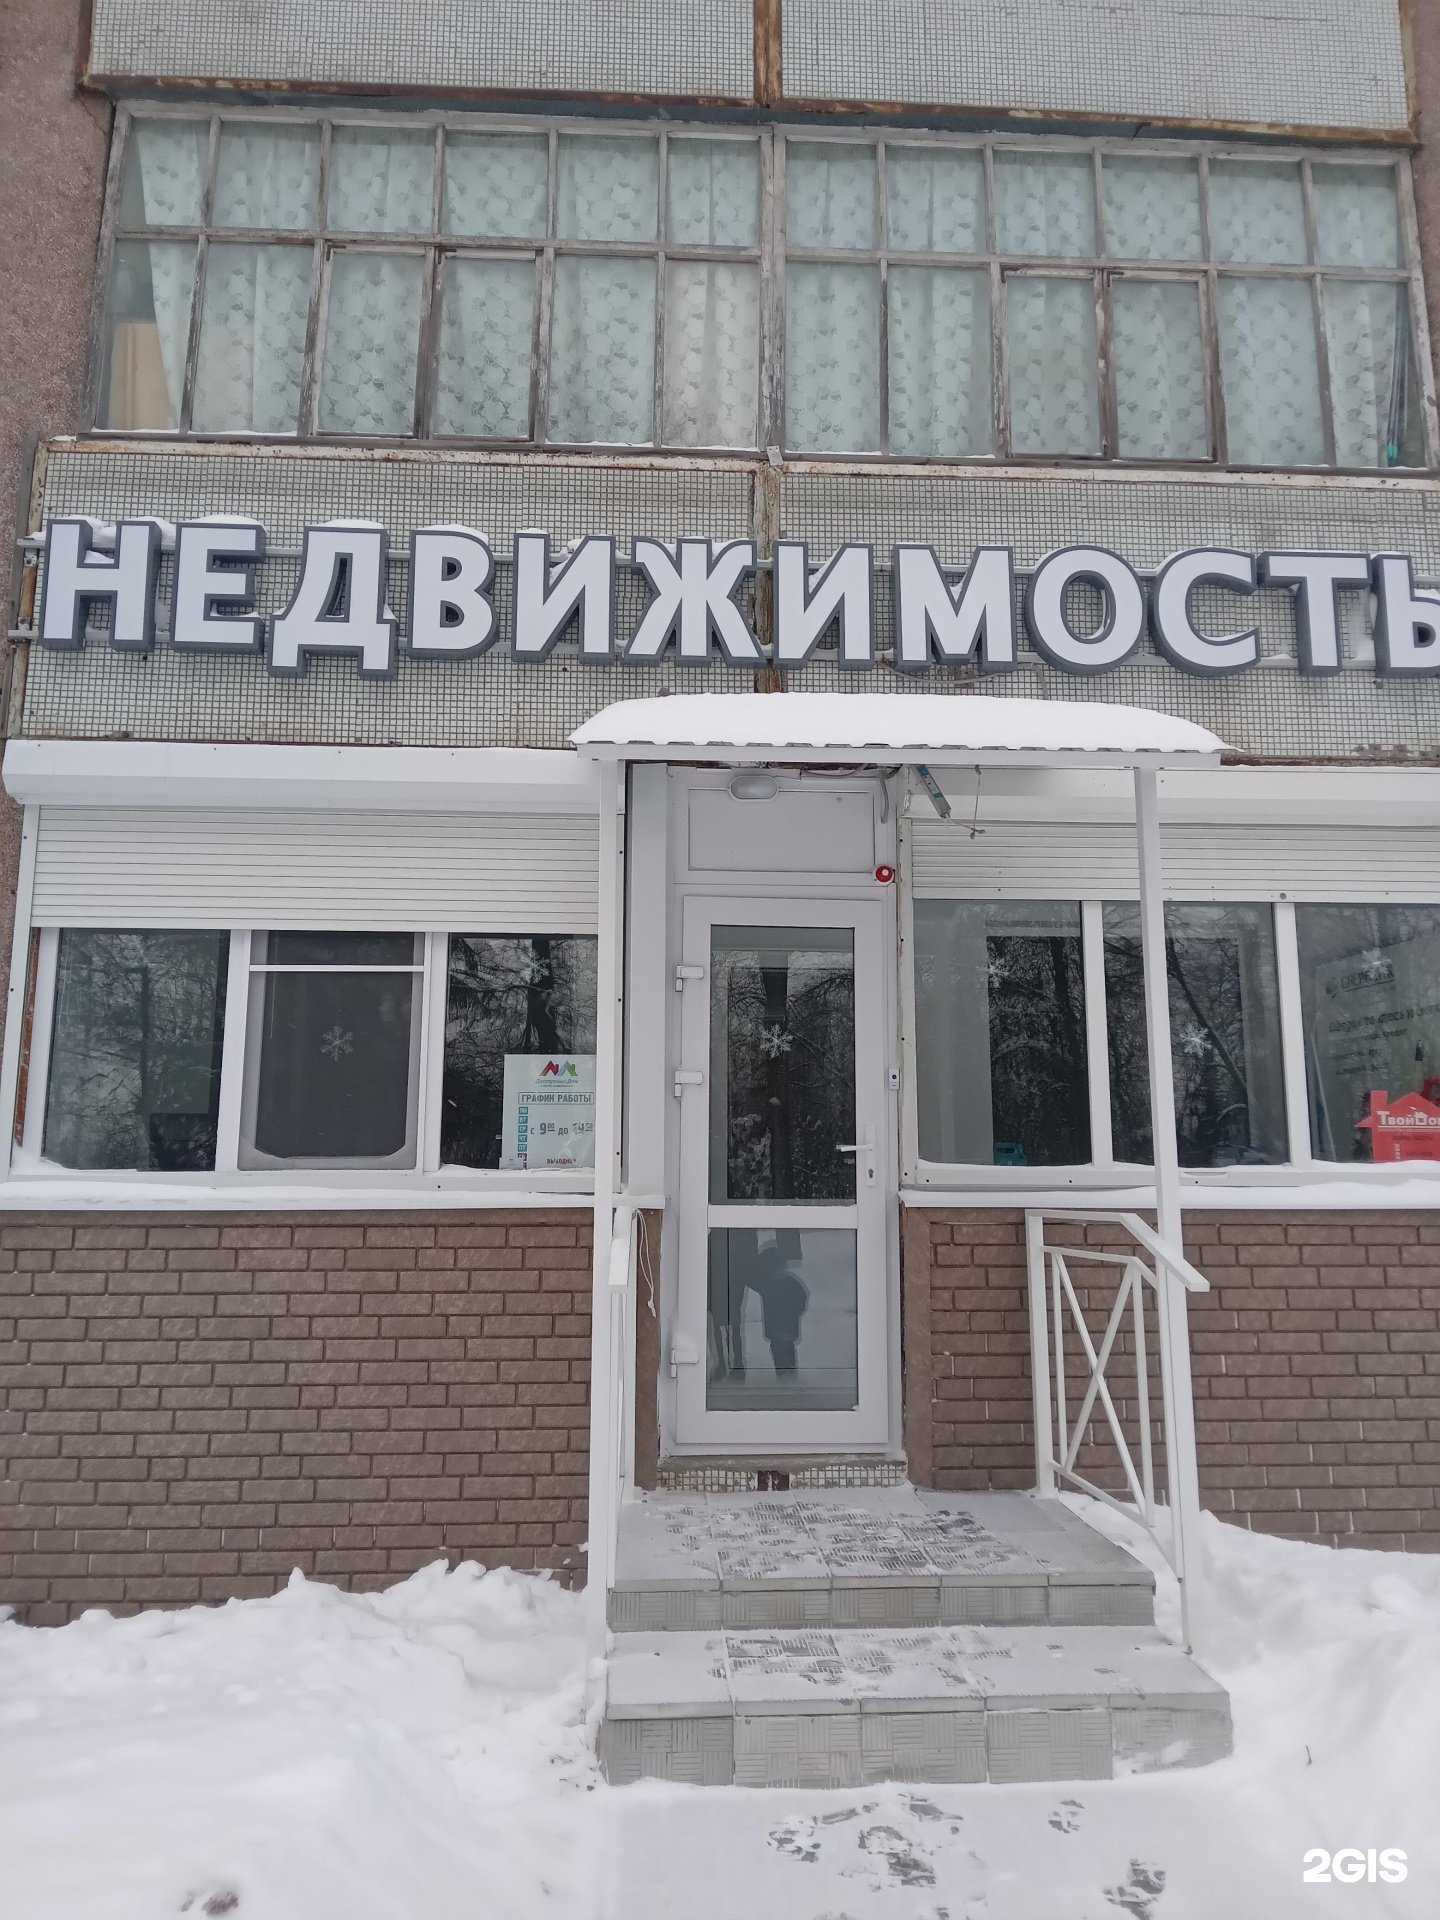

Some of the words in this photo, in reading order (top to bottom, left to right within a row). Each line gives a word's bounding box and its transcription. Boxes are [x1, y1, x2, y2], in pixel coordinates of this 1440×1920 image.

[42, 518, 1440, 677] НЕДВИЖИМОСТЬ
[557, 1094, 592, 1103] РАБОТЫ
[1375, 1110, 1440, 1127] ТвойДо
